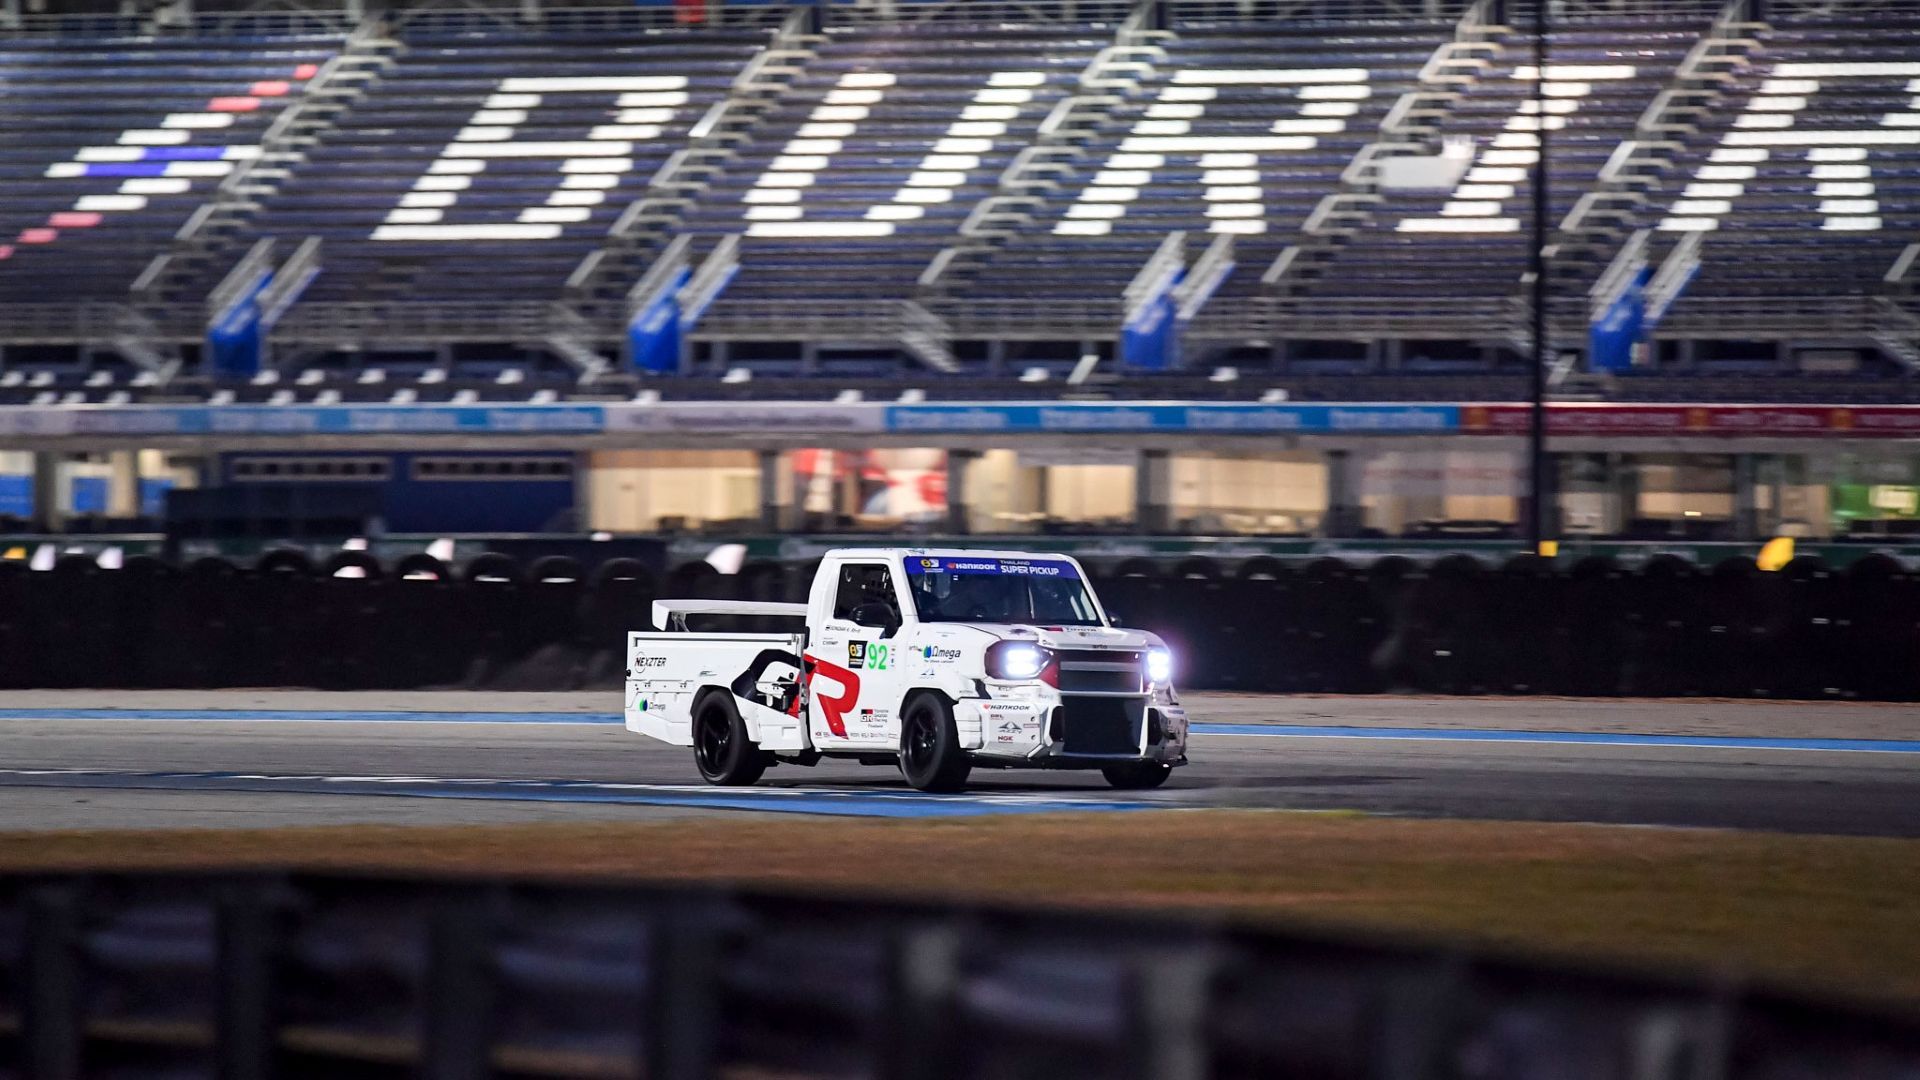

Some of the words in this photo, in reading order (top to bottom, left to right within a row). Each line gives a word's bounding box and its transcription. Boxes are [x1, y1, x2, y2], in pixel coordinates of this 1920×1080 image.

[1000, 565, 1028, 574] SUPER
[1029, 566, 1060, 575] PICKUP
[868, 643, 887, 670] 92
[634, 657, 667, 667] NEXZTER
